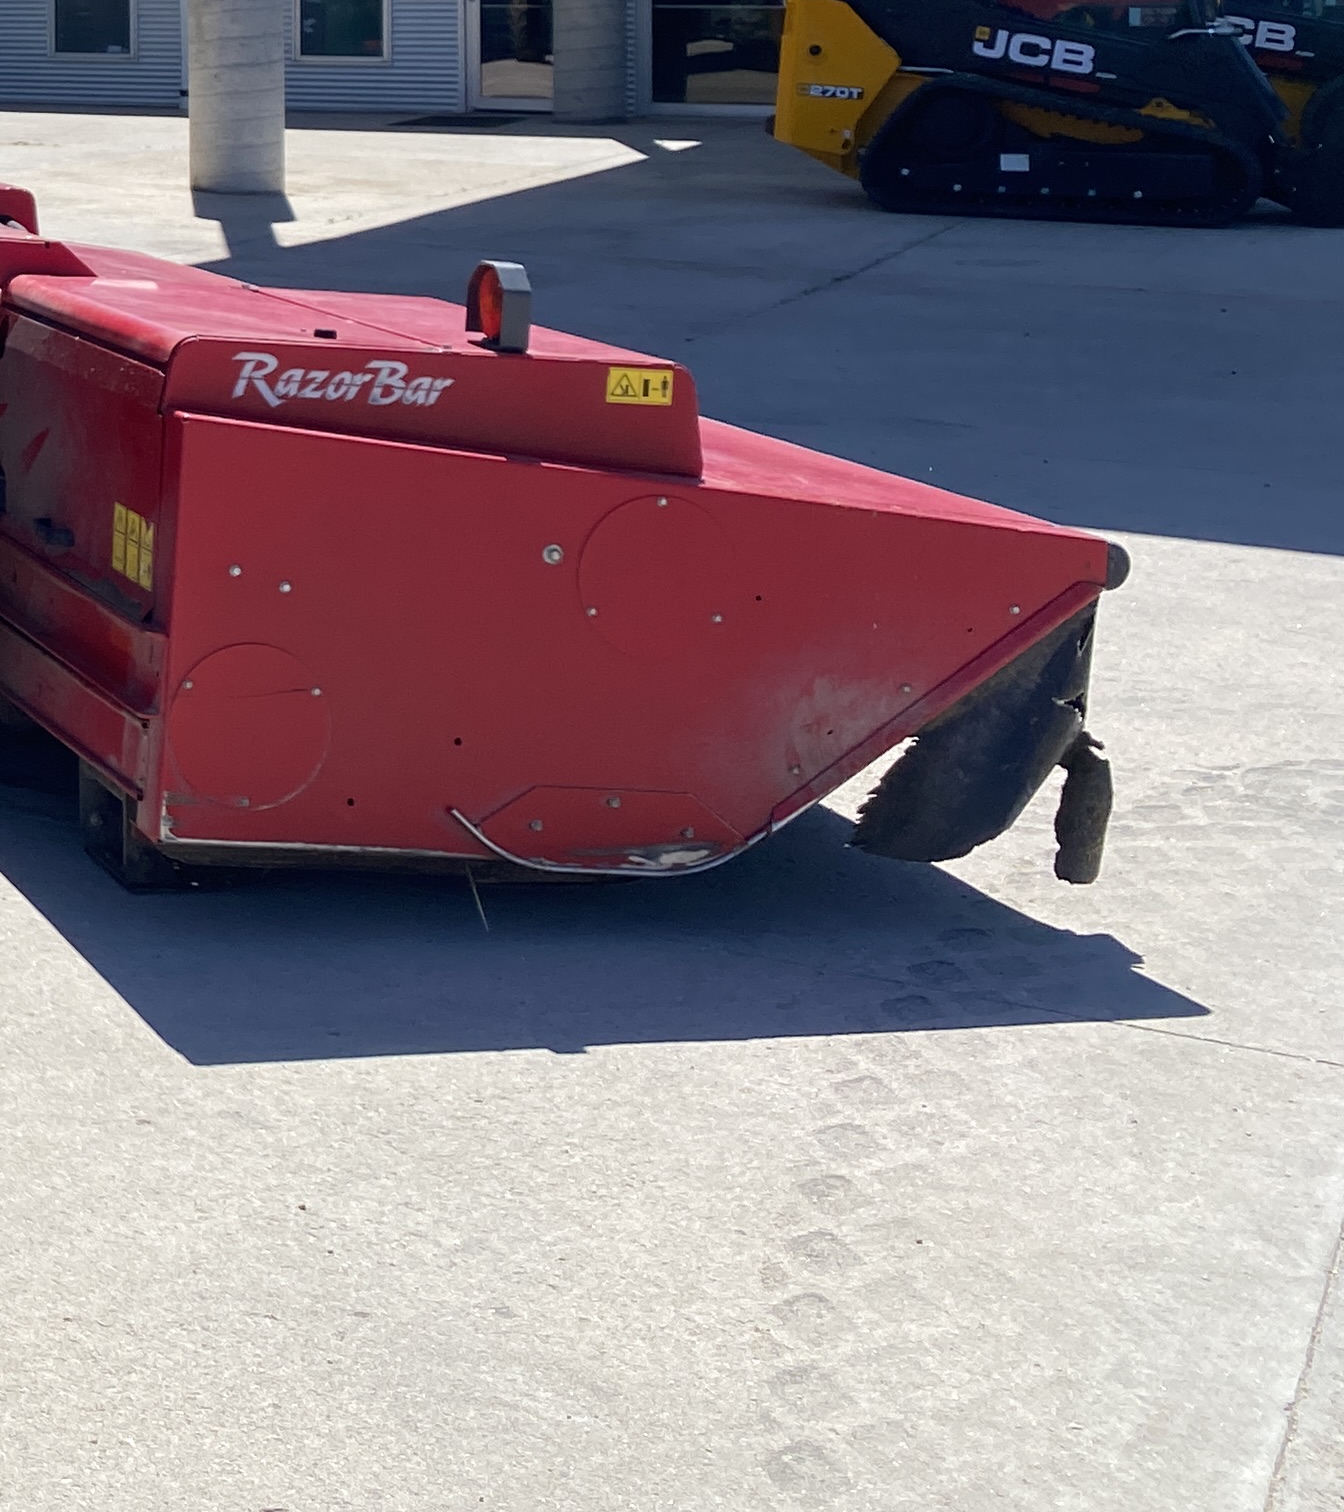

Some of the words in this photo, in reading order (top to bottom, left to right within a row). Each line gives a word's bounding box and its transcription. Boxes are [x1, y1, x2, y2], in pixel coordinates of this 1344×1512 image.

[973, 28, 1096, 75] JCB
[1218, 15, 1297, 52] CB
[231, 351, 455, 408] RazorBar
